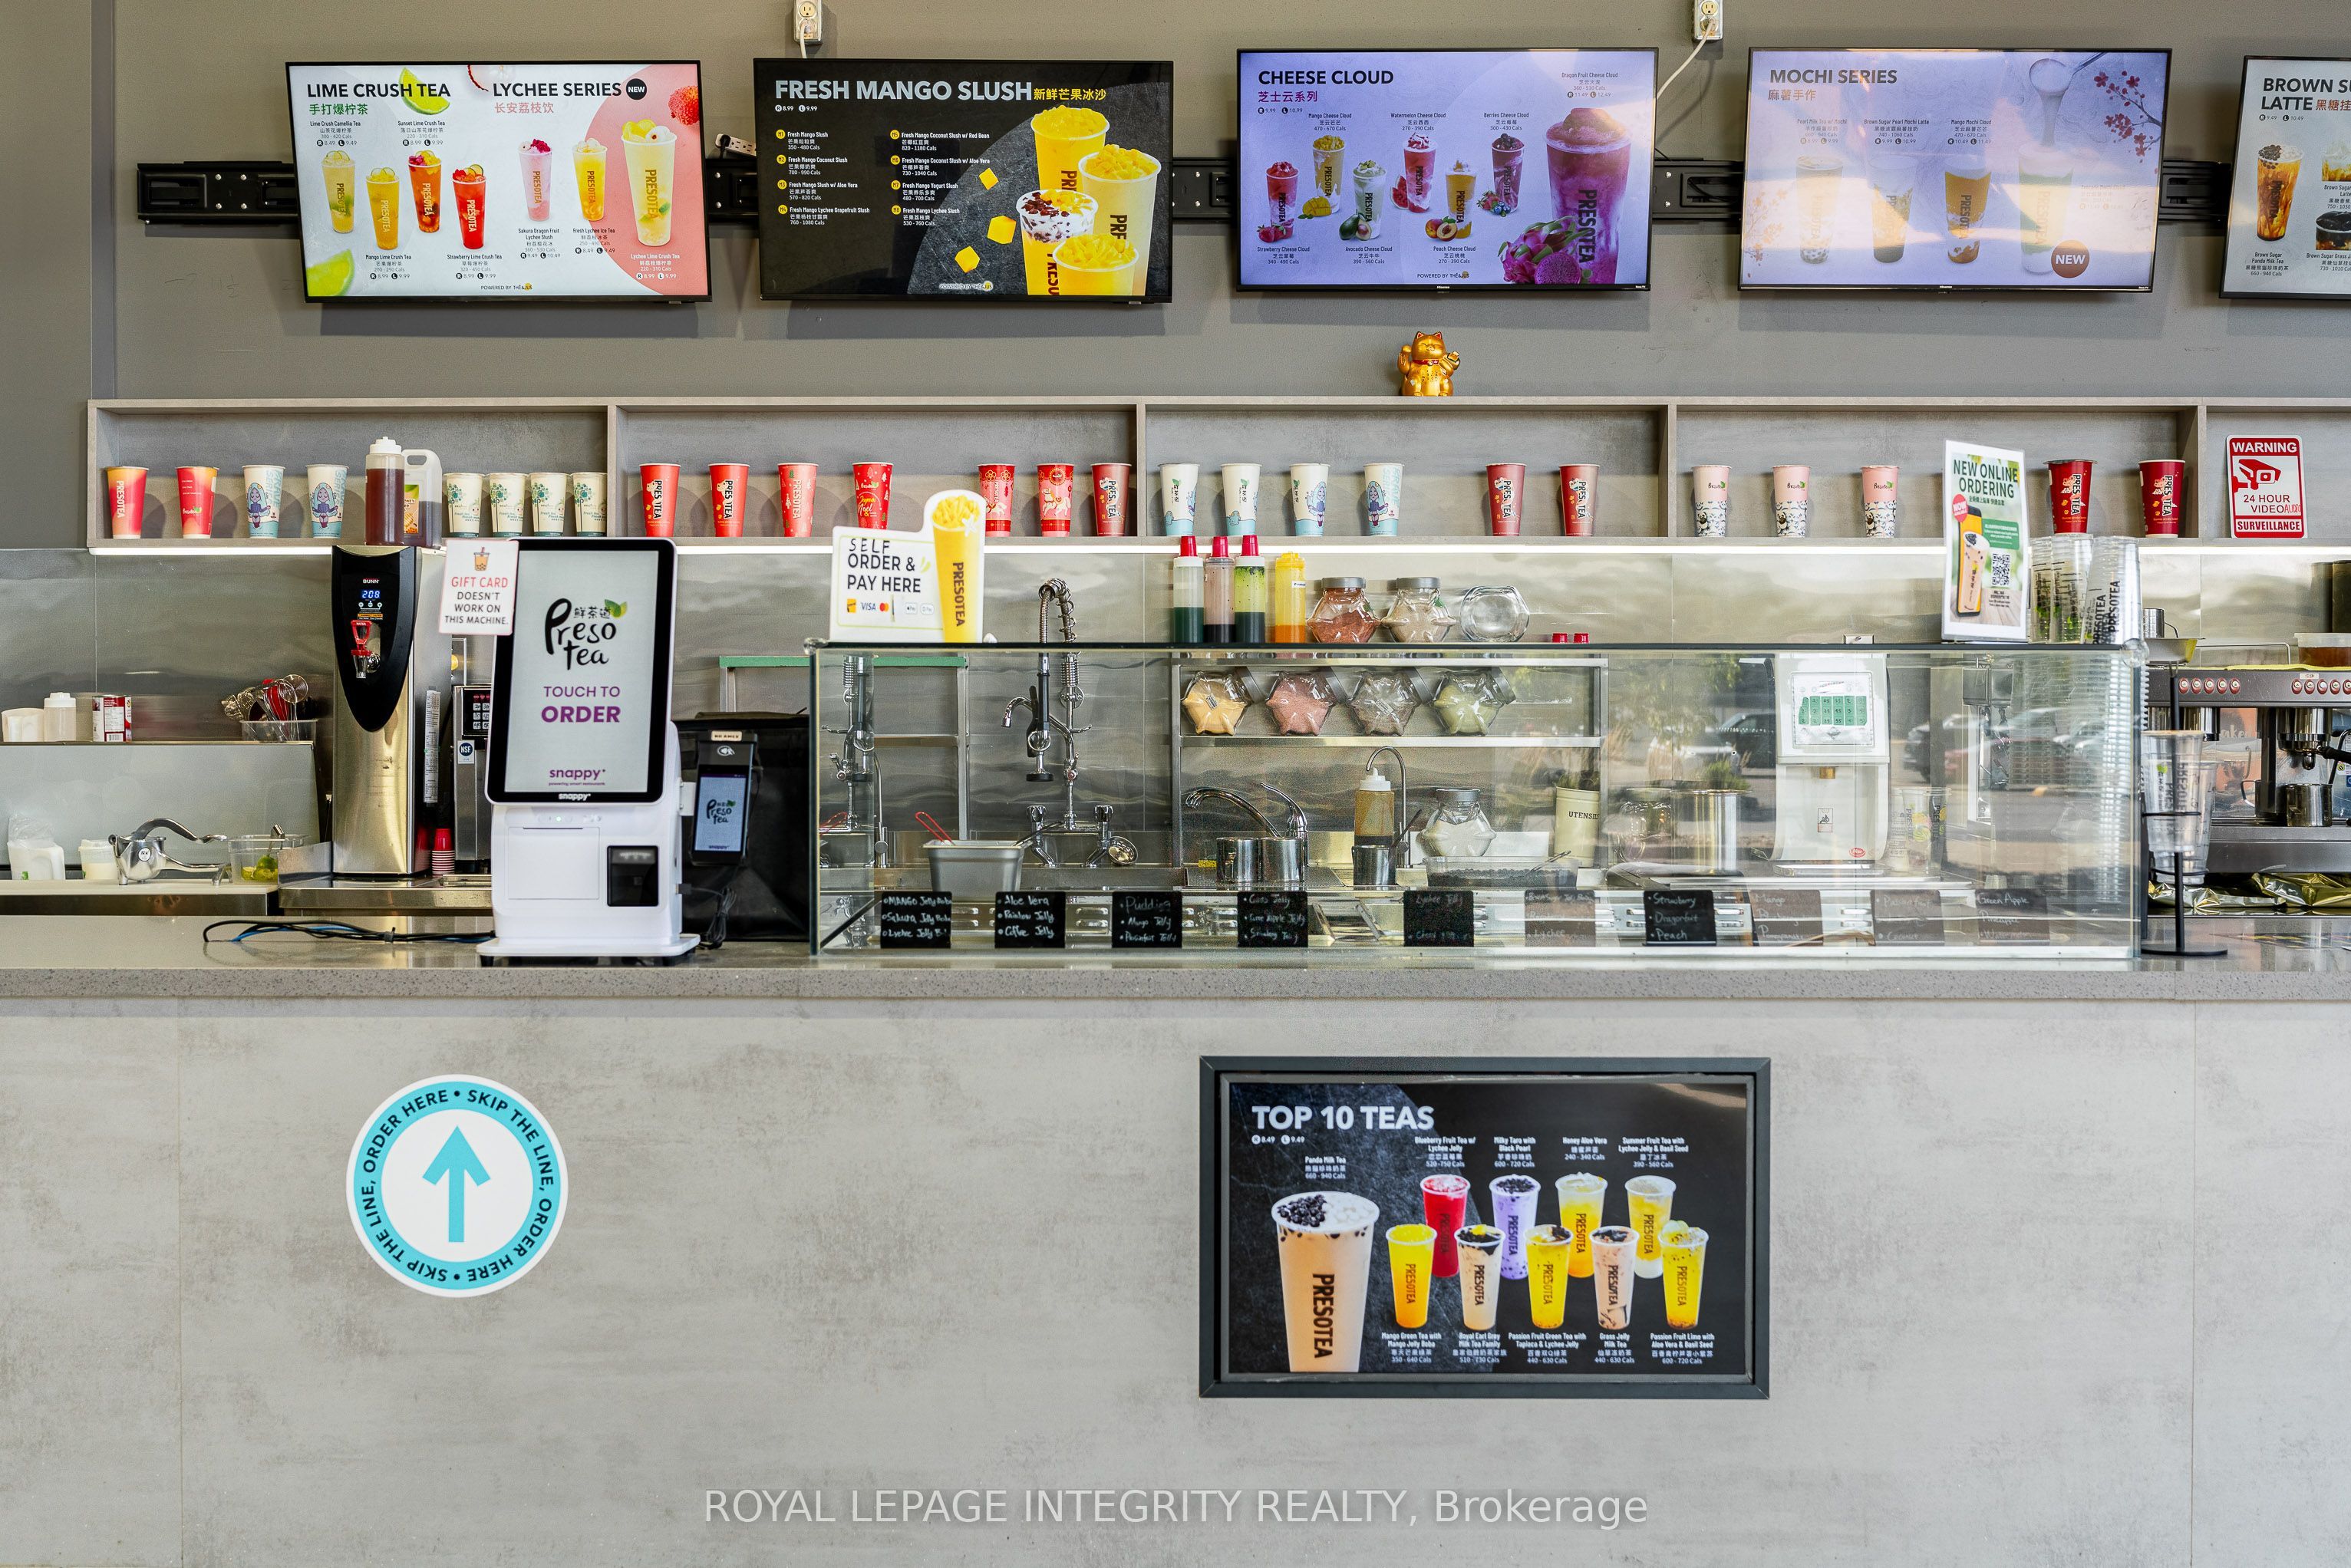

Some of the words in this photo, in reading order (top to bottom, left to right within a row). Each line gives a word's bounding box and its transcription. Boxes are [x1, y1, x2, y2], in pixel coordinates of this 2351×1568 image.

[1258, 71, 1327, 84] CHEESE
[1331, 71, 1394, 84] CLOUD
[1770, 70, 1832, 84] MOCHI
[1838, 70, 1898, 84] SERIES
[2264, 78, 2333, 93] BROWN
[308, 84, 348, 97] LIME
[354, 84, 413, 97] CRUSH
[417, 84, 450, 97] TEA
[493, 82, 559, 97] LYCHEE
[563, 82, 622, 97] SERIES
[776, 80, 849, 99] FRESH
[857, 81, 952, 100] MANGO
[958, 81, 1032, 100] SLUSH
[1034, 88, 1106, 100] 新鲜芒果冰沙
[1258, 91, 1317, 102] 芝士云系列
[1768, 89, 1816, 100] 麻薯手作
[309, 104, 368, 115] 手打爆柠茶
[494, 102, 554, 114] 长安荔枝饮
[2261, 97, 2313, 111] LATTE
[467, 199, 476, 232] PRESOTEA
[1578, 189, 1598, 263] PRESOTEA
[2056, 254, 2086, 265] NEW
[2232, 442, 2297, 452] WARNING
[1954, 459, 1977, 476] NEW
[1980, 463, 2018, 483] ONLINE
[1959, 477, 2014, 498] ORDERING
[117, 481, 125, 519] PRESOTEA
[2237, 521, 2300, 530] SURVEILLANCE
[849, 538, 890, 554] SELF
[848, 553, 901, 571] ORDER
[905, 557, 915, 572] &
[451, 577, 476, 587] GIFT
[480, 577, 508, 588] CARD
[847, 575, 877, 591] PAY
[882, 577, 921, 592] HERE
[362, 590, 380, 598] 208
[457, 591, 500, 600] DOESN'T
[952, 562, 965, 627] PRESOTEA
[454, 604, 483, 612] WORK
[860, 602, 876, 611] VISA
[2107, 580, 2121, 633] PRESOTEA
[445, 615, 463, 624] THIS
[467, 616, 509, 624] MACHINE.
[545, 598, 617, 654] Preso
[563, 640, 609, 670] tea
[543, 687, 596, 697] TOUCH
[601, 687, 621, 697] TO
[541, 706, 621, 723] ORDER
[2003, 892, 2030, 908] Apple
[1656, 928, 1687, 940] Peach
[401, 1089, 449, 1117] HERE
[467, 1089, 509, 1112] SKIP
[510, 1109, 539, 1142] THE
[1251, 1106, 1312, 1129] TOP
[1321, 1106, 1354, 1129] 10
[1360, 1106, 1434, 1129] TEAS
[363, 1115, 403, 1173] ORDER
[533, 1145, 554, 1191] LINE,
[361, 1180, 381, 1227] LINE,
[513, 1198, 552, 1257] ORDER
[376, 1228, 406, 1263] THE
[407, 1260, 447, 1282] SKIP
[467, 1254, 514, 1282] HERE
[1406, 1263, 1416, 1304] PRESOTEA
[1474, 1264, 1485, 1306] PRESOTEA
[1312, 1273, 1335, 1359] PRESOTEA
